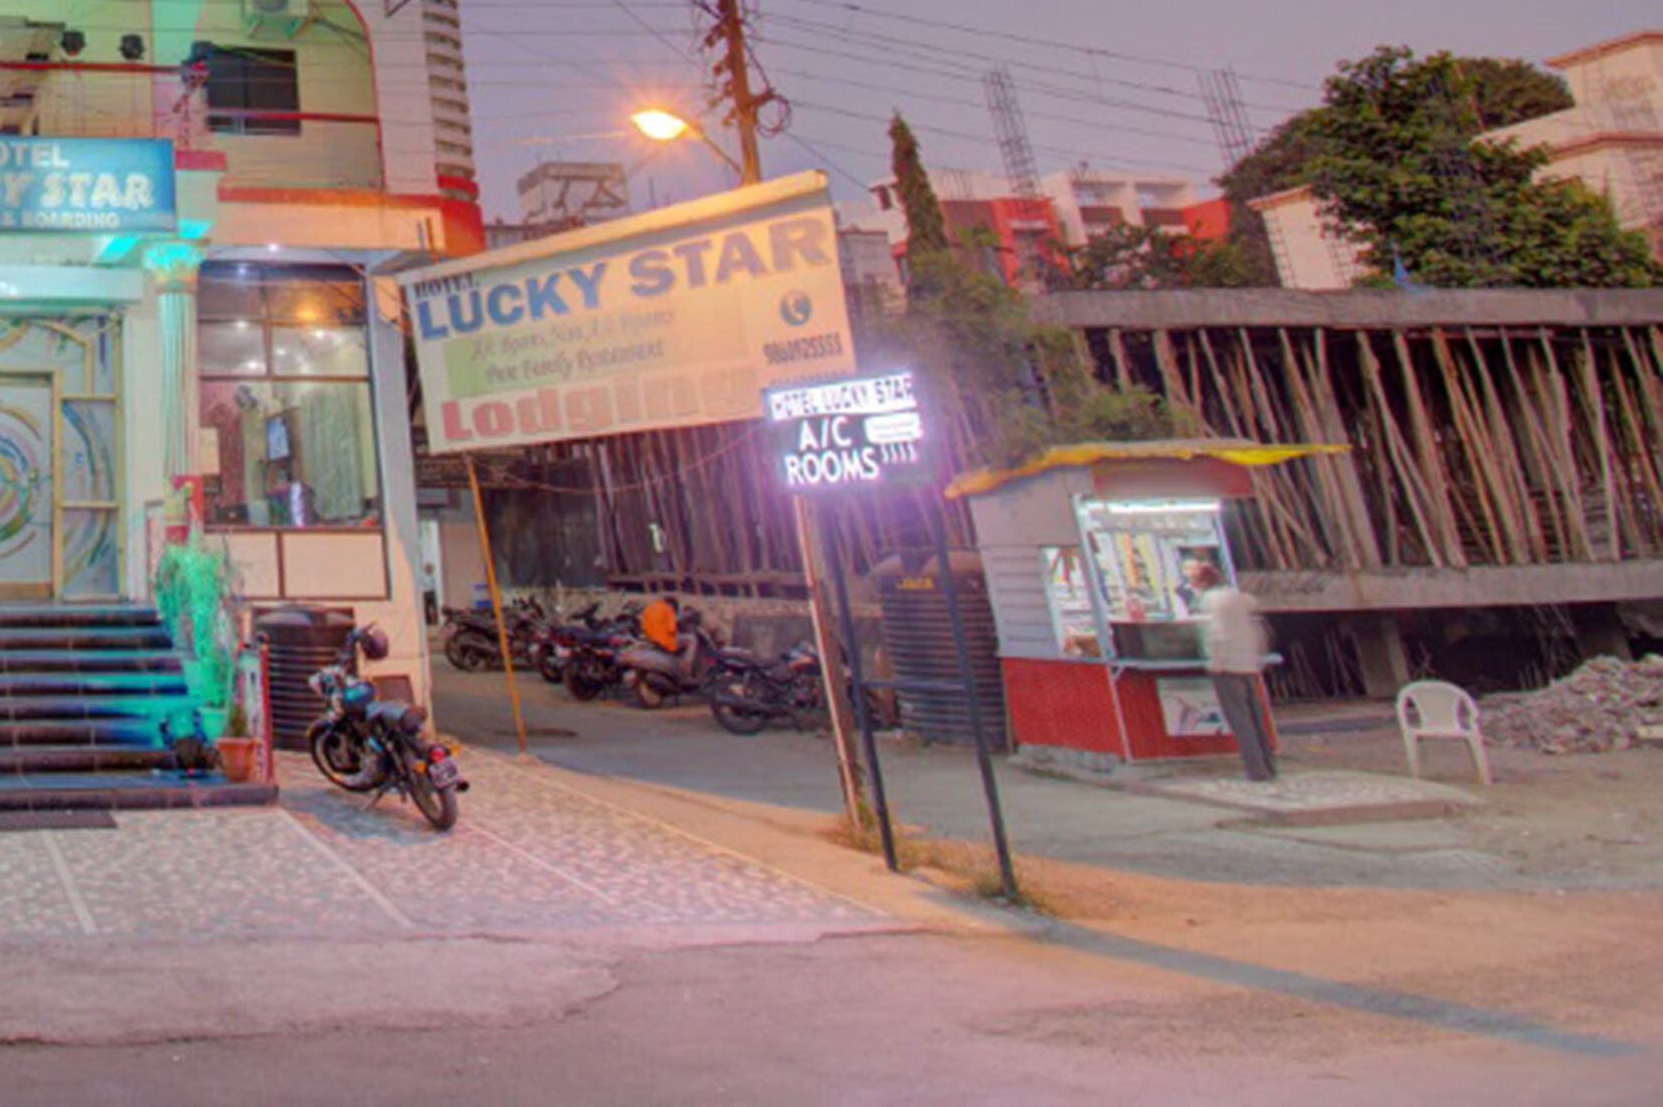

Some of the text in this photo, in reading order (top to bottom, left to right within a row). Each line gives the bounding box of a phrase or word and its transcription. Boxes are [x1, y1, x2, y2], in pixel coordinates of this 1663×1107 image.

[41, 171, 156, 212] STAR
[22, 211, 121, 229] BOARDING
[416, 216, 834, 341] LUCKY STAR
[441, 366, 757, 442] Lodging
[772, 389, 819, 418] HOTEL
[821, 383, 870, 412] LUCKY
[799, 416, 853, 452] A/C
[785, 447, 885, 486] ROOMS
